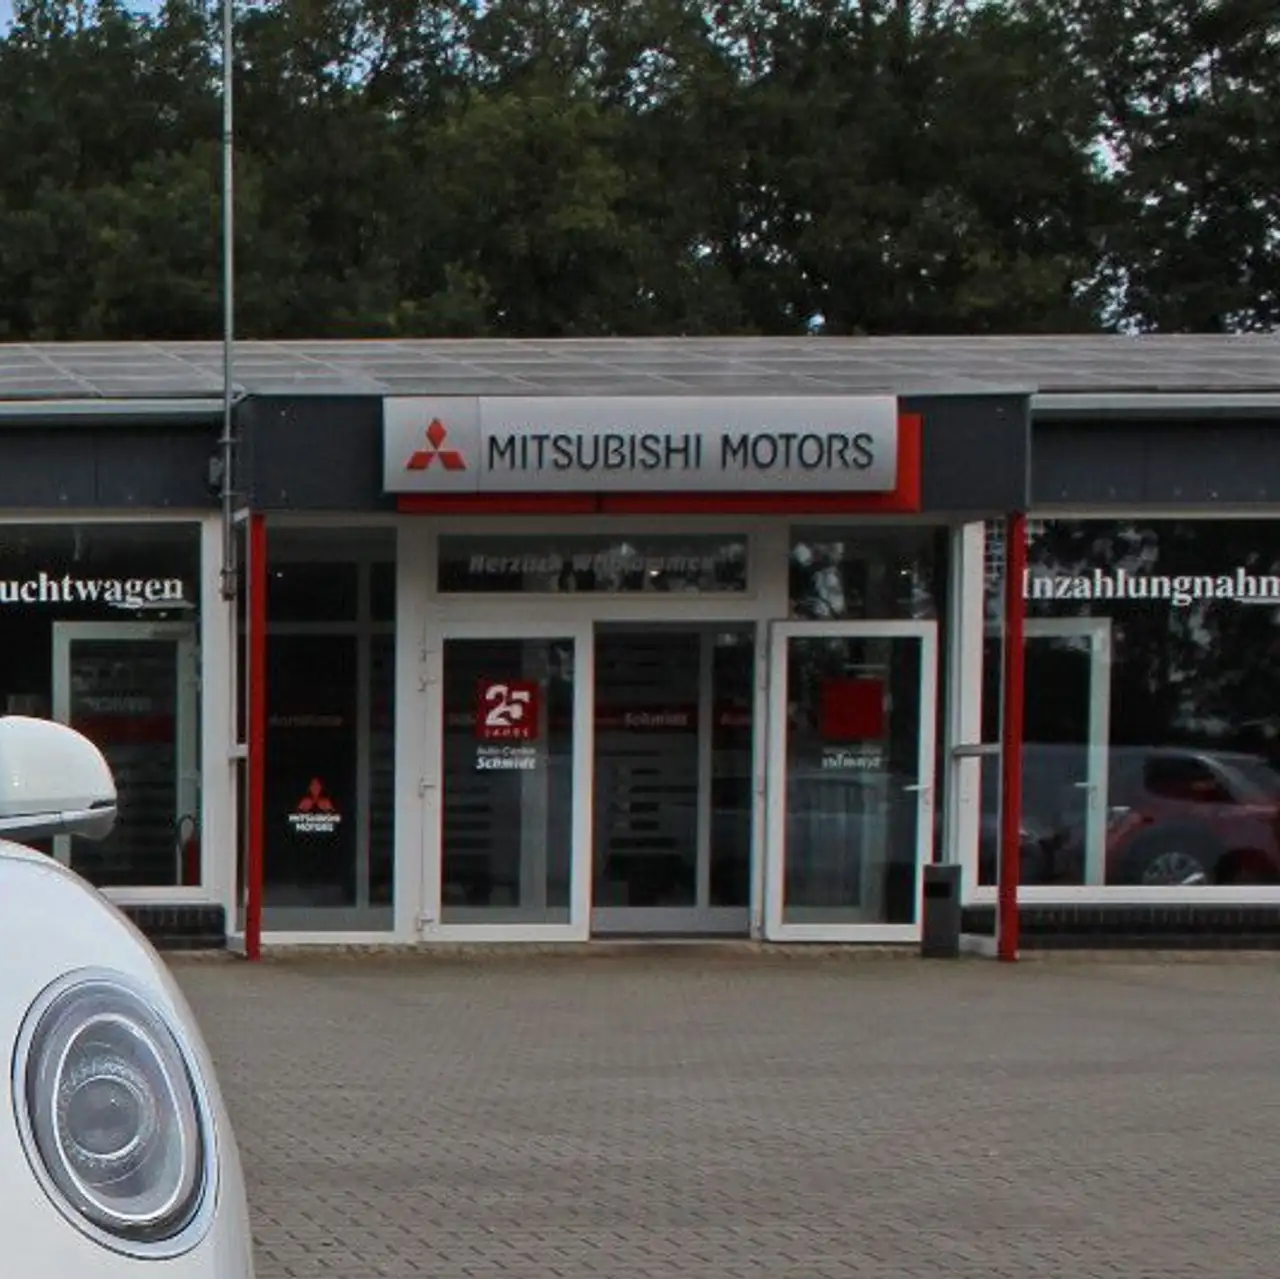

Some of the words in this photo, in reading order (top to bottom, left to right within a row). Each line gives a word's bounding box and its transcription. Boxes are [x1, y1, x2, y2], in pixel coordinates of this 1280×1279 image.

[488, 434, 702, 471] MITSUBISHI
[720, 433, 874, 470] MOTORS
[485, 684, 530, 726] 25
[476, 756, 536, 770] Schmidt
